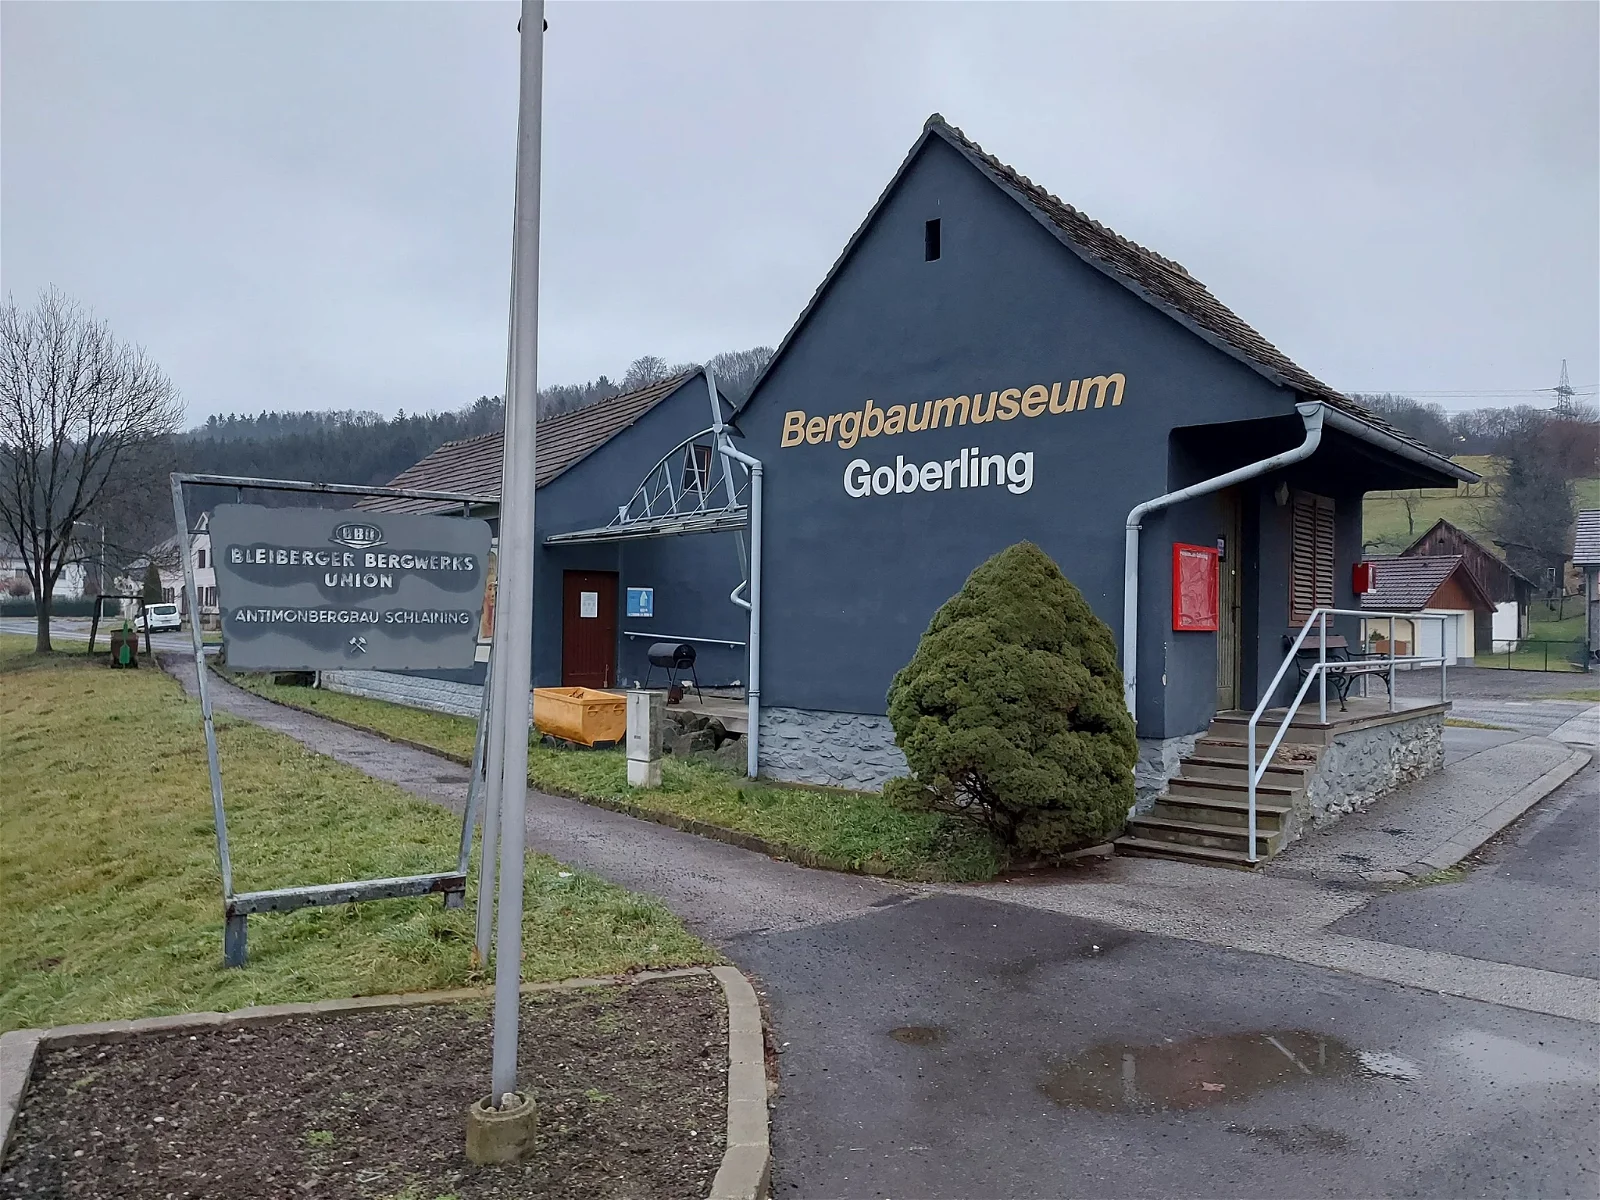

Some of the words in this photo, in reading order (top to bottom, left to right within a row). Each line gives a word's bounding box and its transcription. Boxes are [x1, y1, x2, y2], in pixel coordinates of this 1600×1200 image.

[780, 372, 1126, 449] Bergbaumuseum
[843, 446, 1034, 498] Goberling
[230, 548, 355, 568] BLEIBERGER
[365, 552, 475, 571] BERGWERKS
[324, 572, 394, 588] UNION
[234, 609, 380, 624] ANTIMONBERGBAU
[384, 611, 470, 625] SCHLAINING
